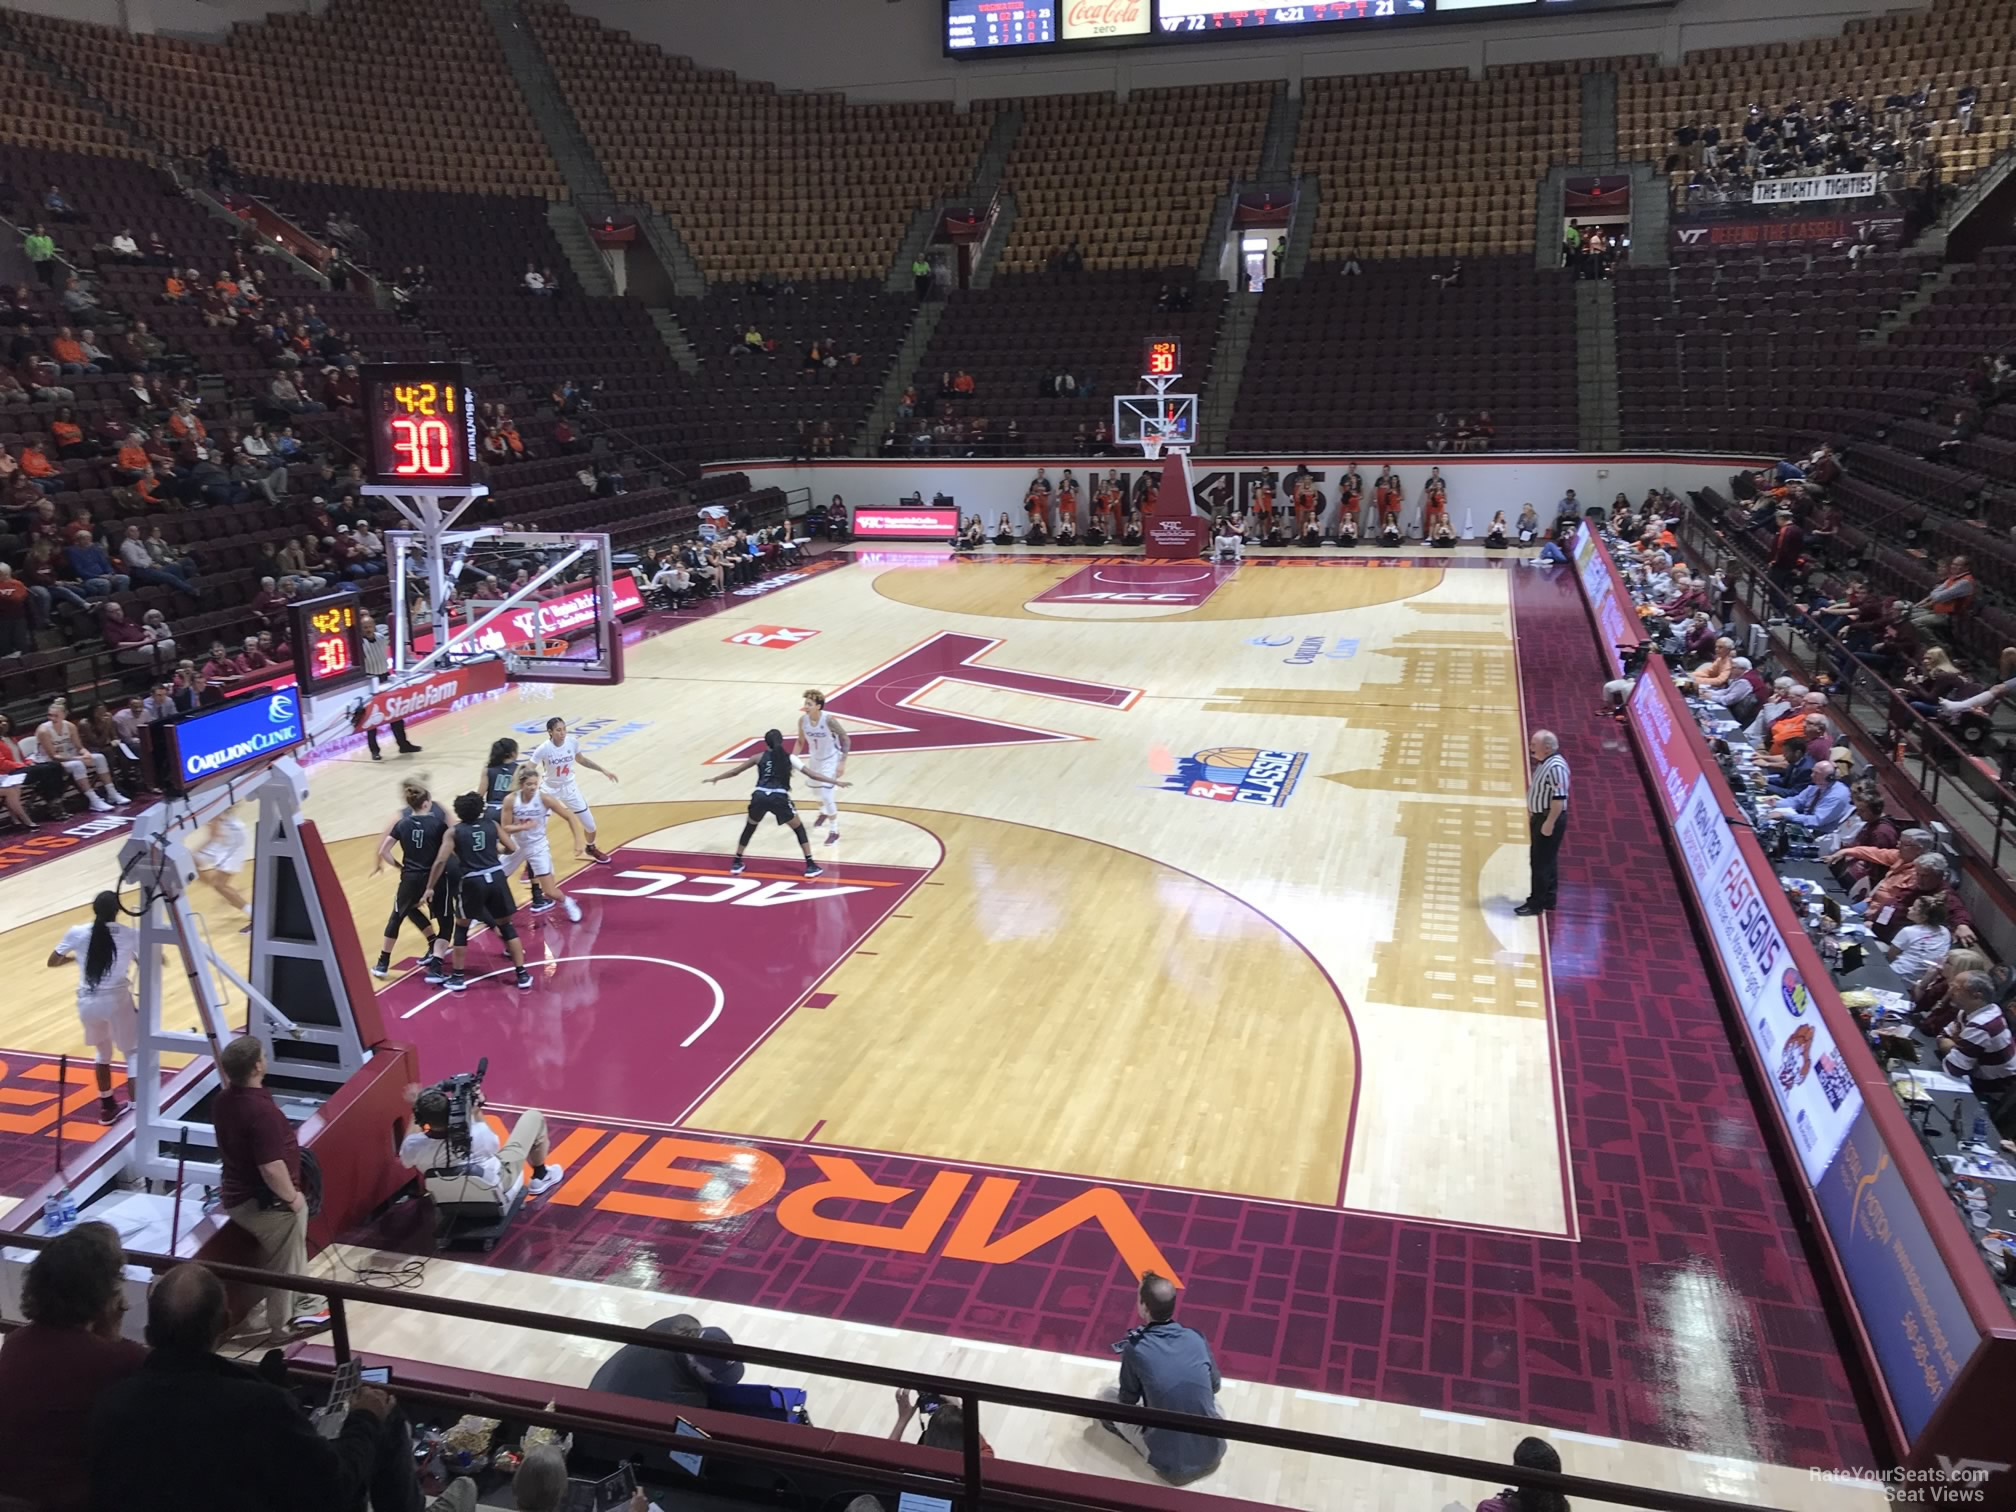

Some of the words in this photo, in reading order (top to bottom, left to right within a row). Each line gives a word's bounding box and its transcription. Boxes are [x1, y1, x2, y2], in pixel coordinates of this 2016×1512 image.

[1275, 8, 1305, 21] 4:21
[1375, 0, 1395, 15] 21
[1093, 25, 1117, 34] zero
[1187, 15, 1206, 30] 72
[1756, 183, 1776, 200] THE
[1825, 175, 1873, 197] TIGHTIES
[1678, 229, 1708, 244] VT
[1711, 227, 1759, 244] DEFEND
[1763, 224, 1787, 241] THE
[1790, 219, 1846, 240] CASSELL
[1151, 353, 1173, 373] 30
[394, 384, 454, 415] 4:21
[391, 419, 451, 474] 30
[1056, 592, 1201, 601] ACC
[312, 608, 352, 634] 4:21
[317, 638, 346, 674] 30
[555, 765, 571, 777] 14
[1235, 750, 1297, 806] CLASSIC
[1191, 783, 1237, 800] 2K
[411, 829, 425, 849] 4
[472, 830, 486, 852] 3
[568, 870, 875, 907] ACC
[485, 1114, 1185, 1290] VIRGI
[1844, 1139, 1862, 1184] TOTAL
[1864, 1189, 1892, 1245] MOTION
